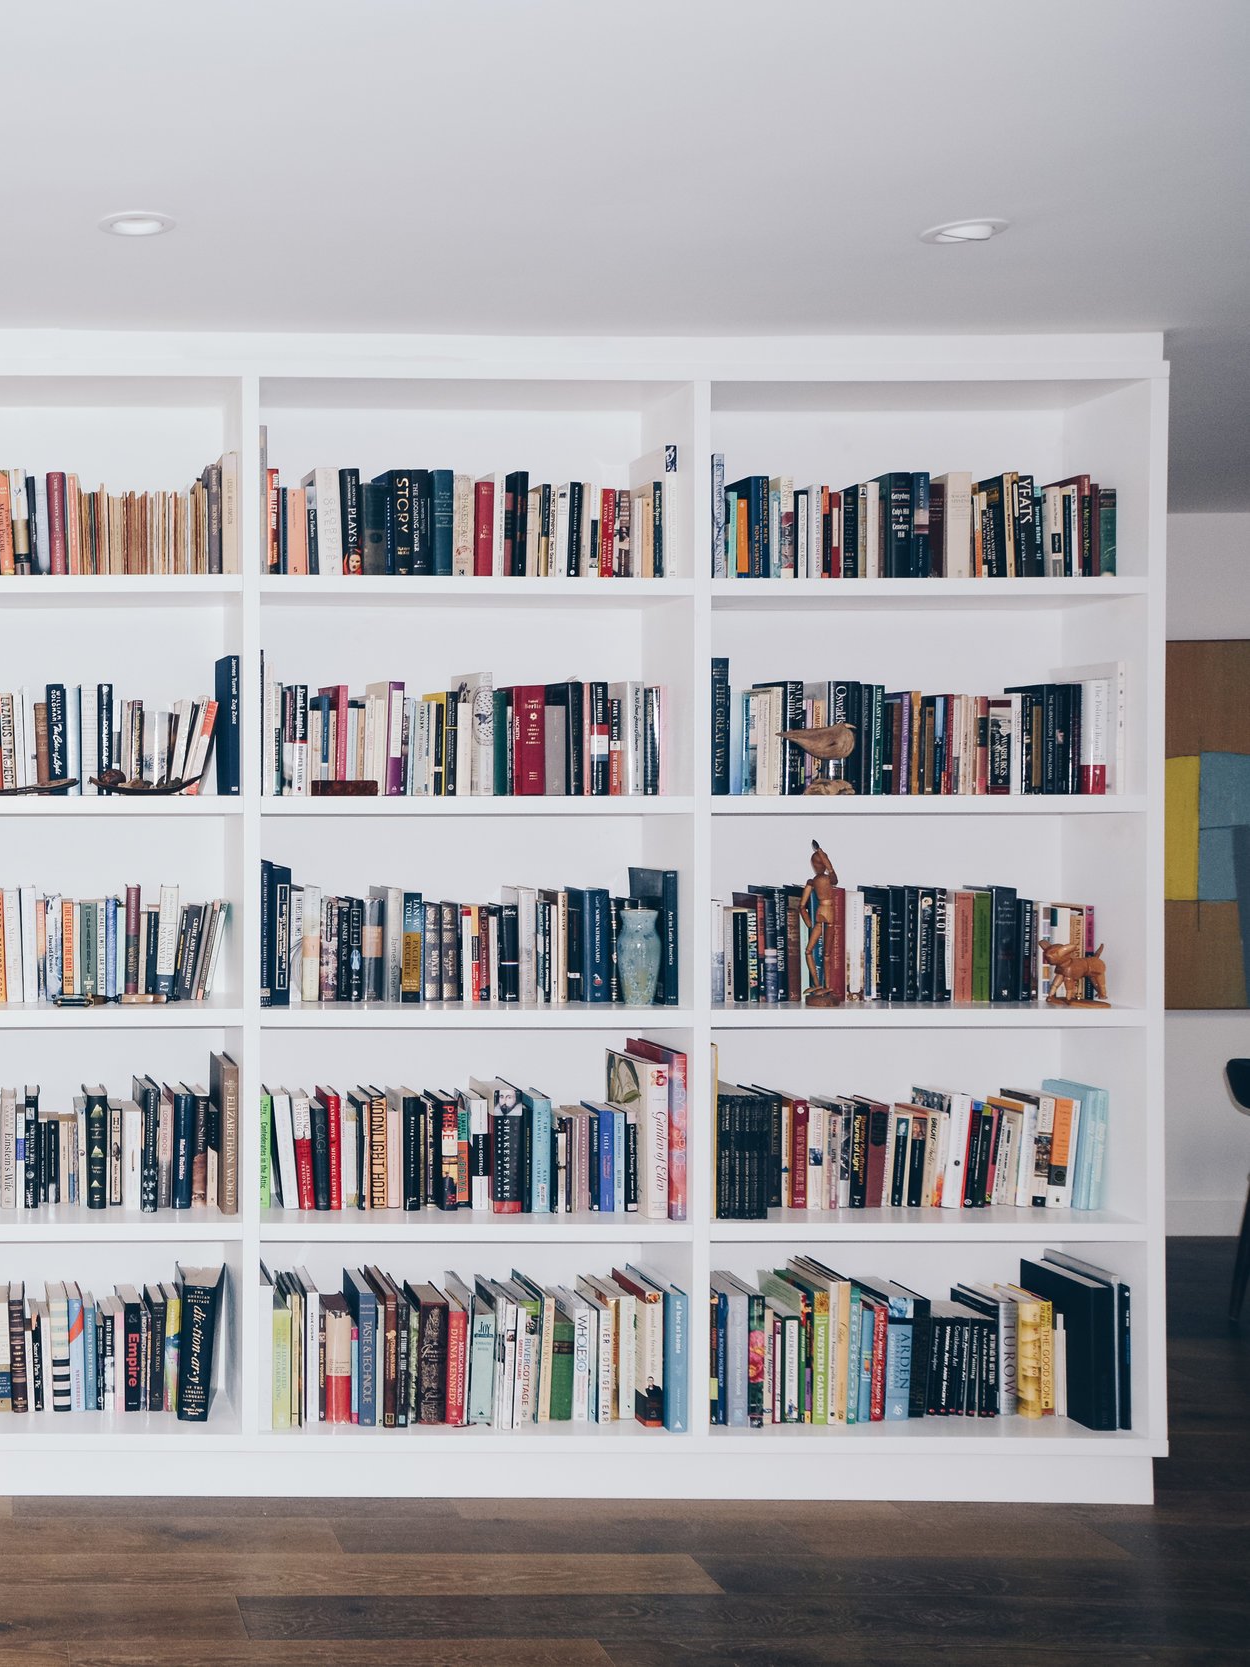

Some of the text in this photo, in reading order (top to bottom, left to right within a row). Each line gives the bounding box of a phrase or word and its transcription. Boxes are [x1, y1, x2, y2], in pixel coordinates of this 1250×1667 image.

[348, 507, 358, 542] PLAYS
[396, 478, 409, 533] STORY
[1018, 479, 1032, 524] YEATS
[229, 699, 237, 710] Zug
[716, 683, 725, 778] THE GREAT WEST
[0, 697, 14, 785] LAZARUS PROJECT
[1000, 737, 1008, 776] WARBURGS
[413, 918, 420, 927] W.
[936, 894, 946, 935] ZEALOT
[390, 936, 398, 989] James Salter
[197, 1100, 206, 1151] James Salter
[316, 1123, 325, 1154] CAGE
[674, 1058, 685, 1170] LUXURY OF SPACE
[4, 1133, 14, 1191] Einstein's Wife
[178, 1139, 186, 1180] Mark Rothko
[226, 1095, 235, 1205] ELIZABETHAN WORLD
[372, 1096, 385, 1208] MOONLIGHT HOTEL
[651, 1111, 667, 1191] Garden of Eden
[675, 1301, 682, 1309] ad
[127, 1333, 139, 1387] Empire
[362, 1321, 372, 1345] TASTE
[1004, 1323, 1016, 1396] TUROW
[362, 1355, 372, 1404] TECHNIQUE
[449, 1328, 458, 1406] DIANA KENNEDY
[817, 1325, 825, 1414] WESTERN GARDEN
[900, 1333, 910, 1389] ARDEN
[1042, 1329, 1050, 1399] THE GOOD SON
